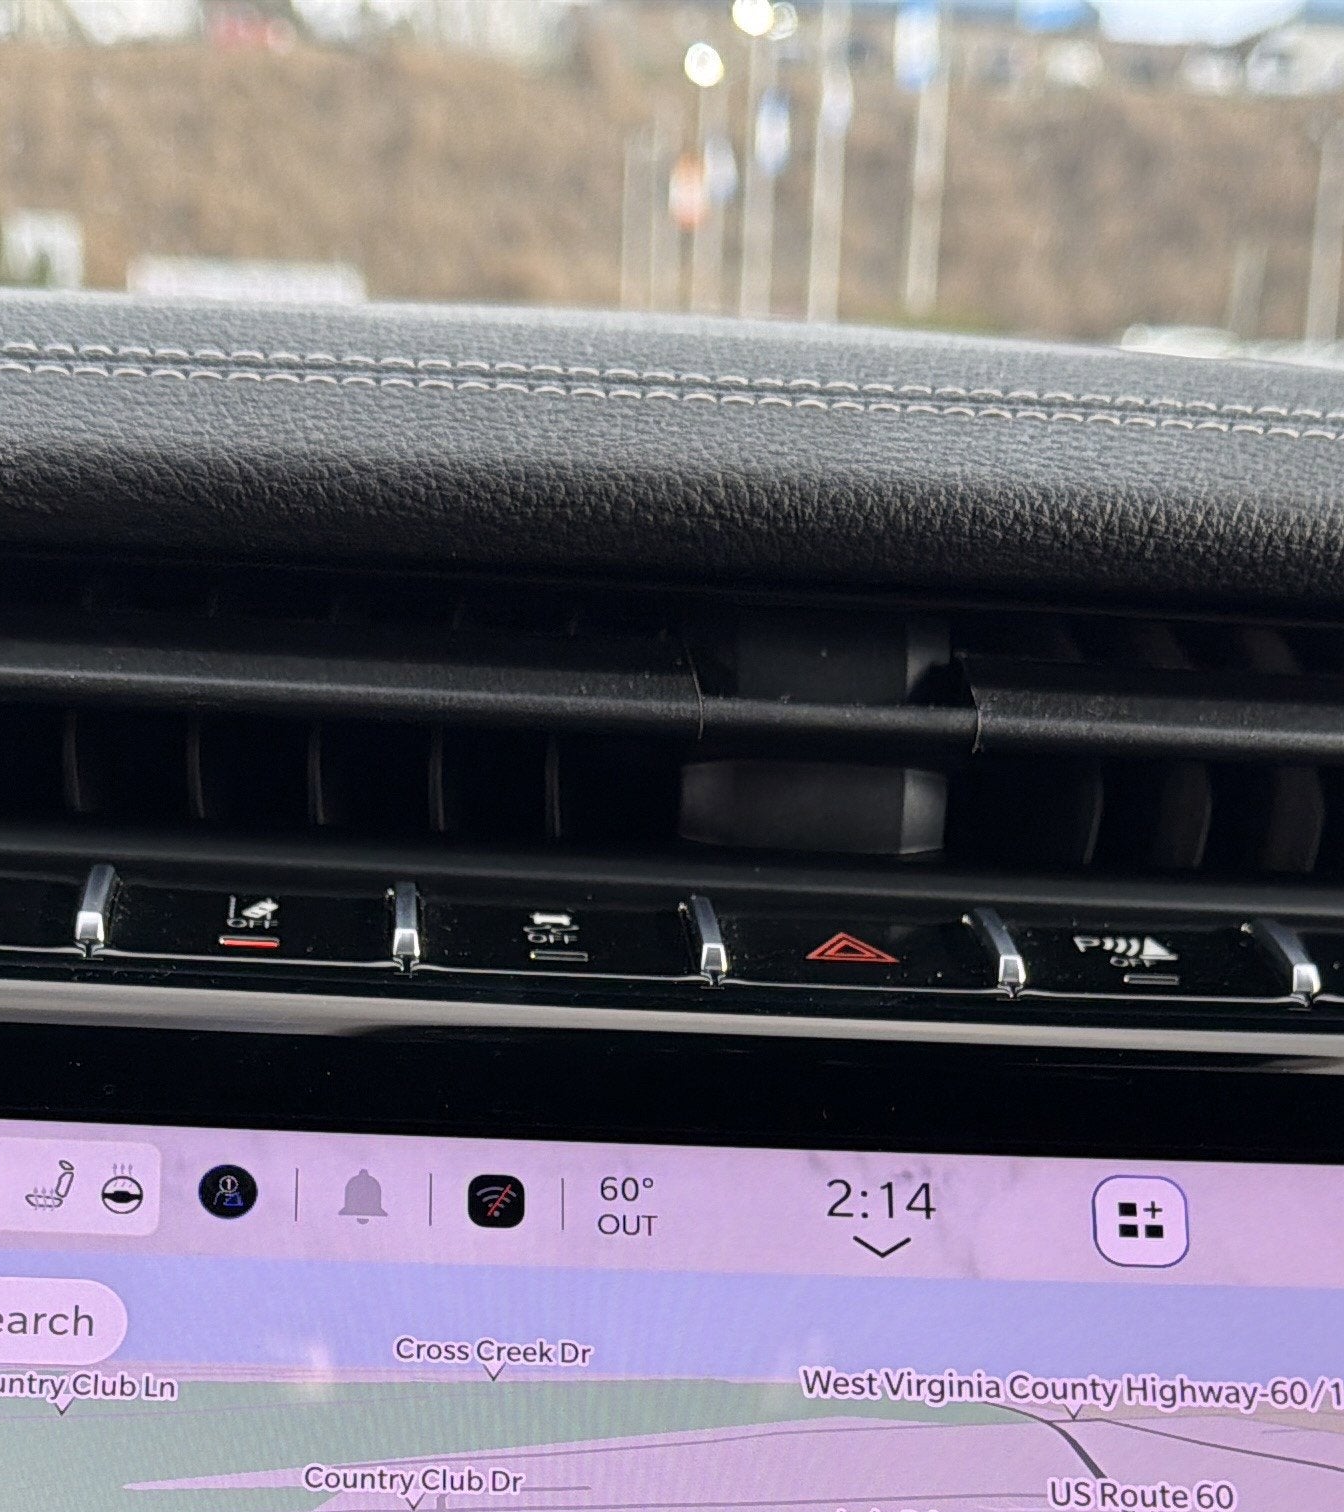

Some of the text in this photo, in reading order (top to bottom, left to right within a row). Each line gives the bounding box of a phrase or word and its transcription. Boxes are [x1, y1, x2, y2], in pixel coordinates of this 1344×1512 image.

[227, 919, 278, 929] OFF
[528, 933, 577, 944] OFF
[1073, 936, 1101, 953] P
[1110, 956, 1156, 967] OFF
[599, 1176, 655, 1203] 60°
[825, 1180, 937, 1220] 2:14
[598, 1213, 658, 1238] OUT
[395, 1338, 592, 1366] Cross Creek Dr
[72, 1372, 138, 1399] Club
[144, 1375, 178, 1400] Ln
[801, 1370, 879, 1397] West
[884, 1371, 1002, 1406] Virginia
[1008, 1375, 1120, 1408] County
[304, 1466, 523, 1497] Country Club Dr
[1049, 1481, 1236, 1510] US Route 60
